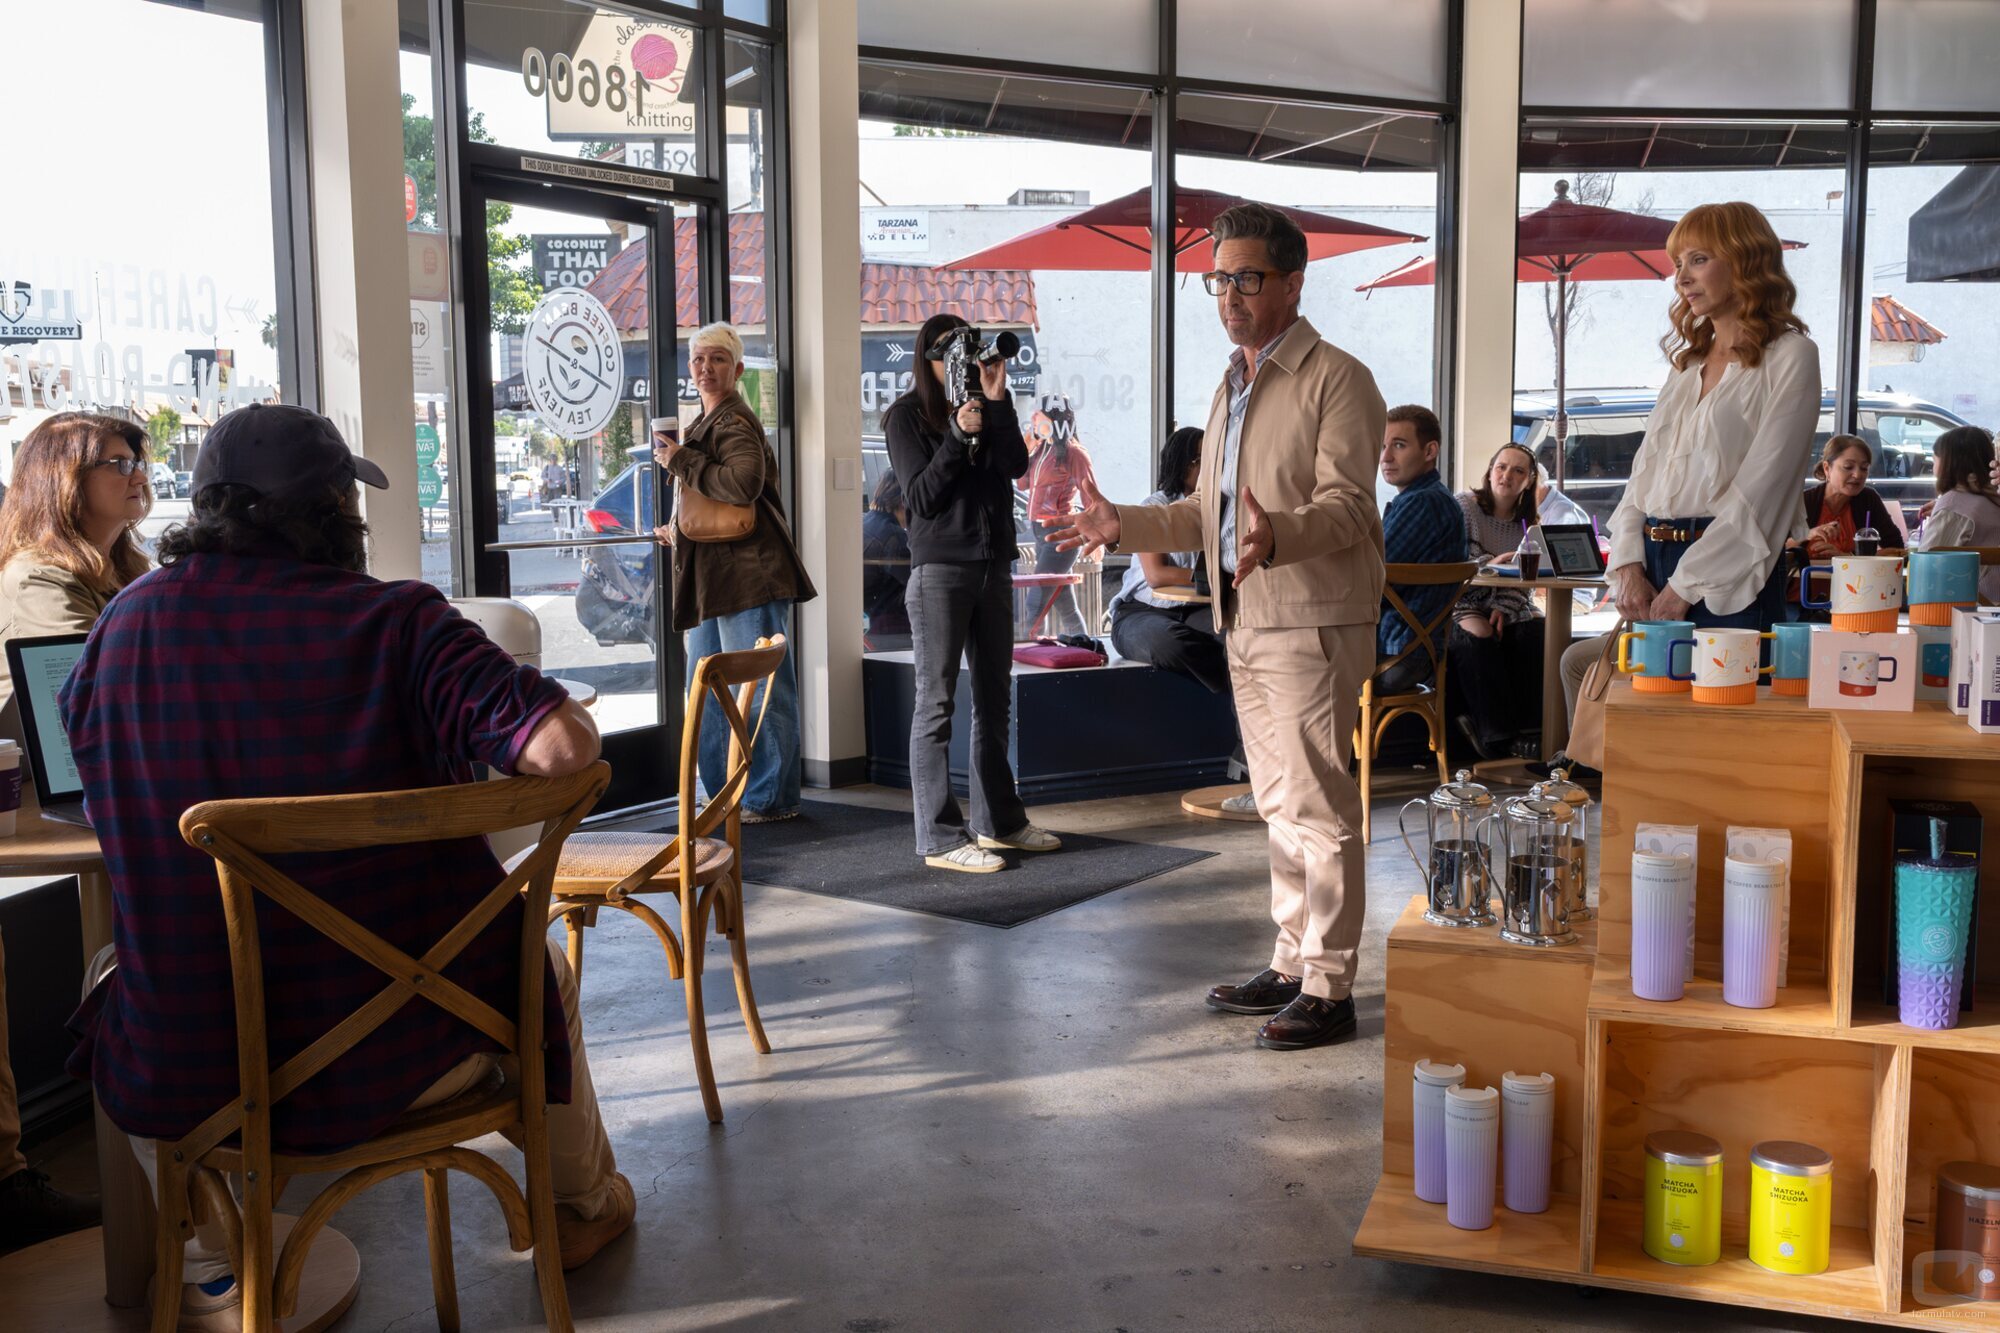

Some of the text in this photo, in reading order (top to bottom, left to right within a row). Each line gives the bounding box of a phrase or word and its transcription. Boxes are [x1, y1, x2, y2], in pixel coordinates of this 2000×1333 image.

[626, 111, 693, 131] knitting
[524, 158, 671, 189] THIS DOOR MUST REMAIN UNLOCKED DURING BUSINESS HOURS
[878, 219, 918, 227] TARZANA
[547, 239, 607, 249] COCONUT
[548, 251, 607, 268] THAI
[545, 270, 600, 287] FOO
[12, 327, 75, 336] RECOVERY
[1018, 376, 1035, 385] 1972
[508, 385, 529, 402] TARZ
[1663, 1178, 1695, 1188] MATCHA
[1660, 1183, 1698, 1195] SHIZUOKA
[1773, 1186, 1805, 1196] MATCHA
[1770, 1192, 1809, 1203] SHIZUOKA
